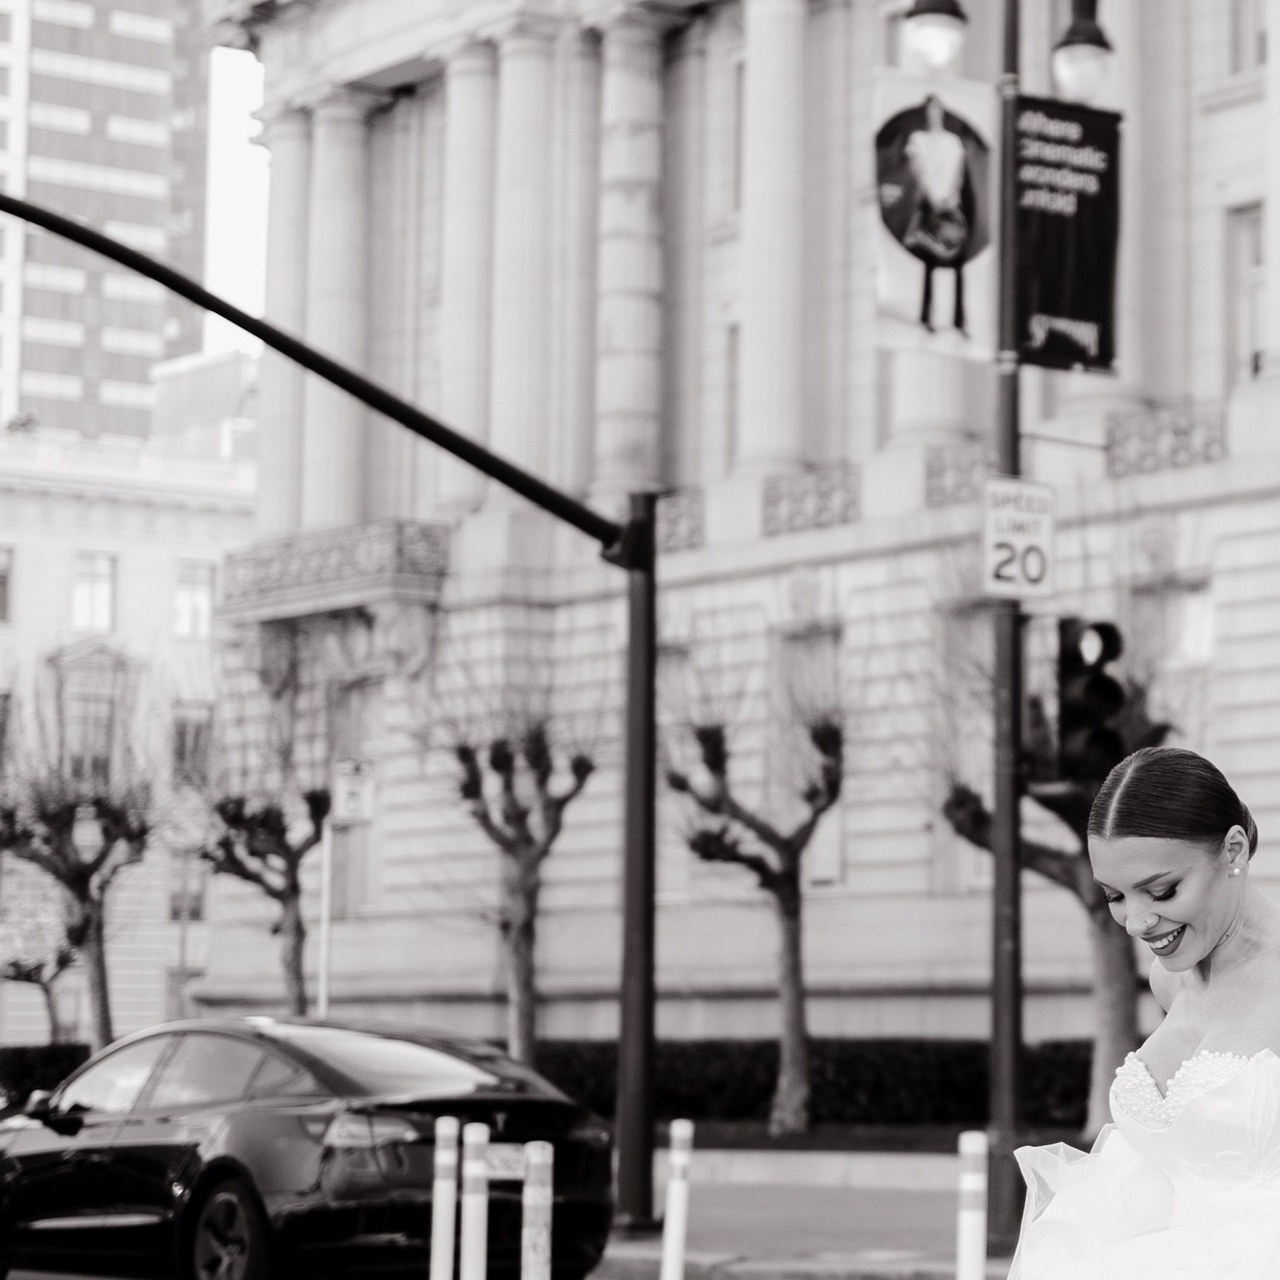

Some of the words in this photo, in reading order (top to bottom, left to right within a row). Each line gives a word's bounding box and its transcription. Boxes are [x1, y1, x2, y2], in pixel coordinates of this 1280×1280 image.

[991, 492, 1049, 514] SPEED
[995, 517, 1042, 535] LIMIT
[993, 541, 1047, 585] 20
